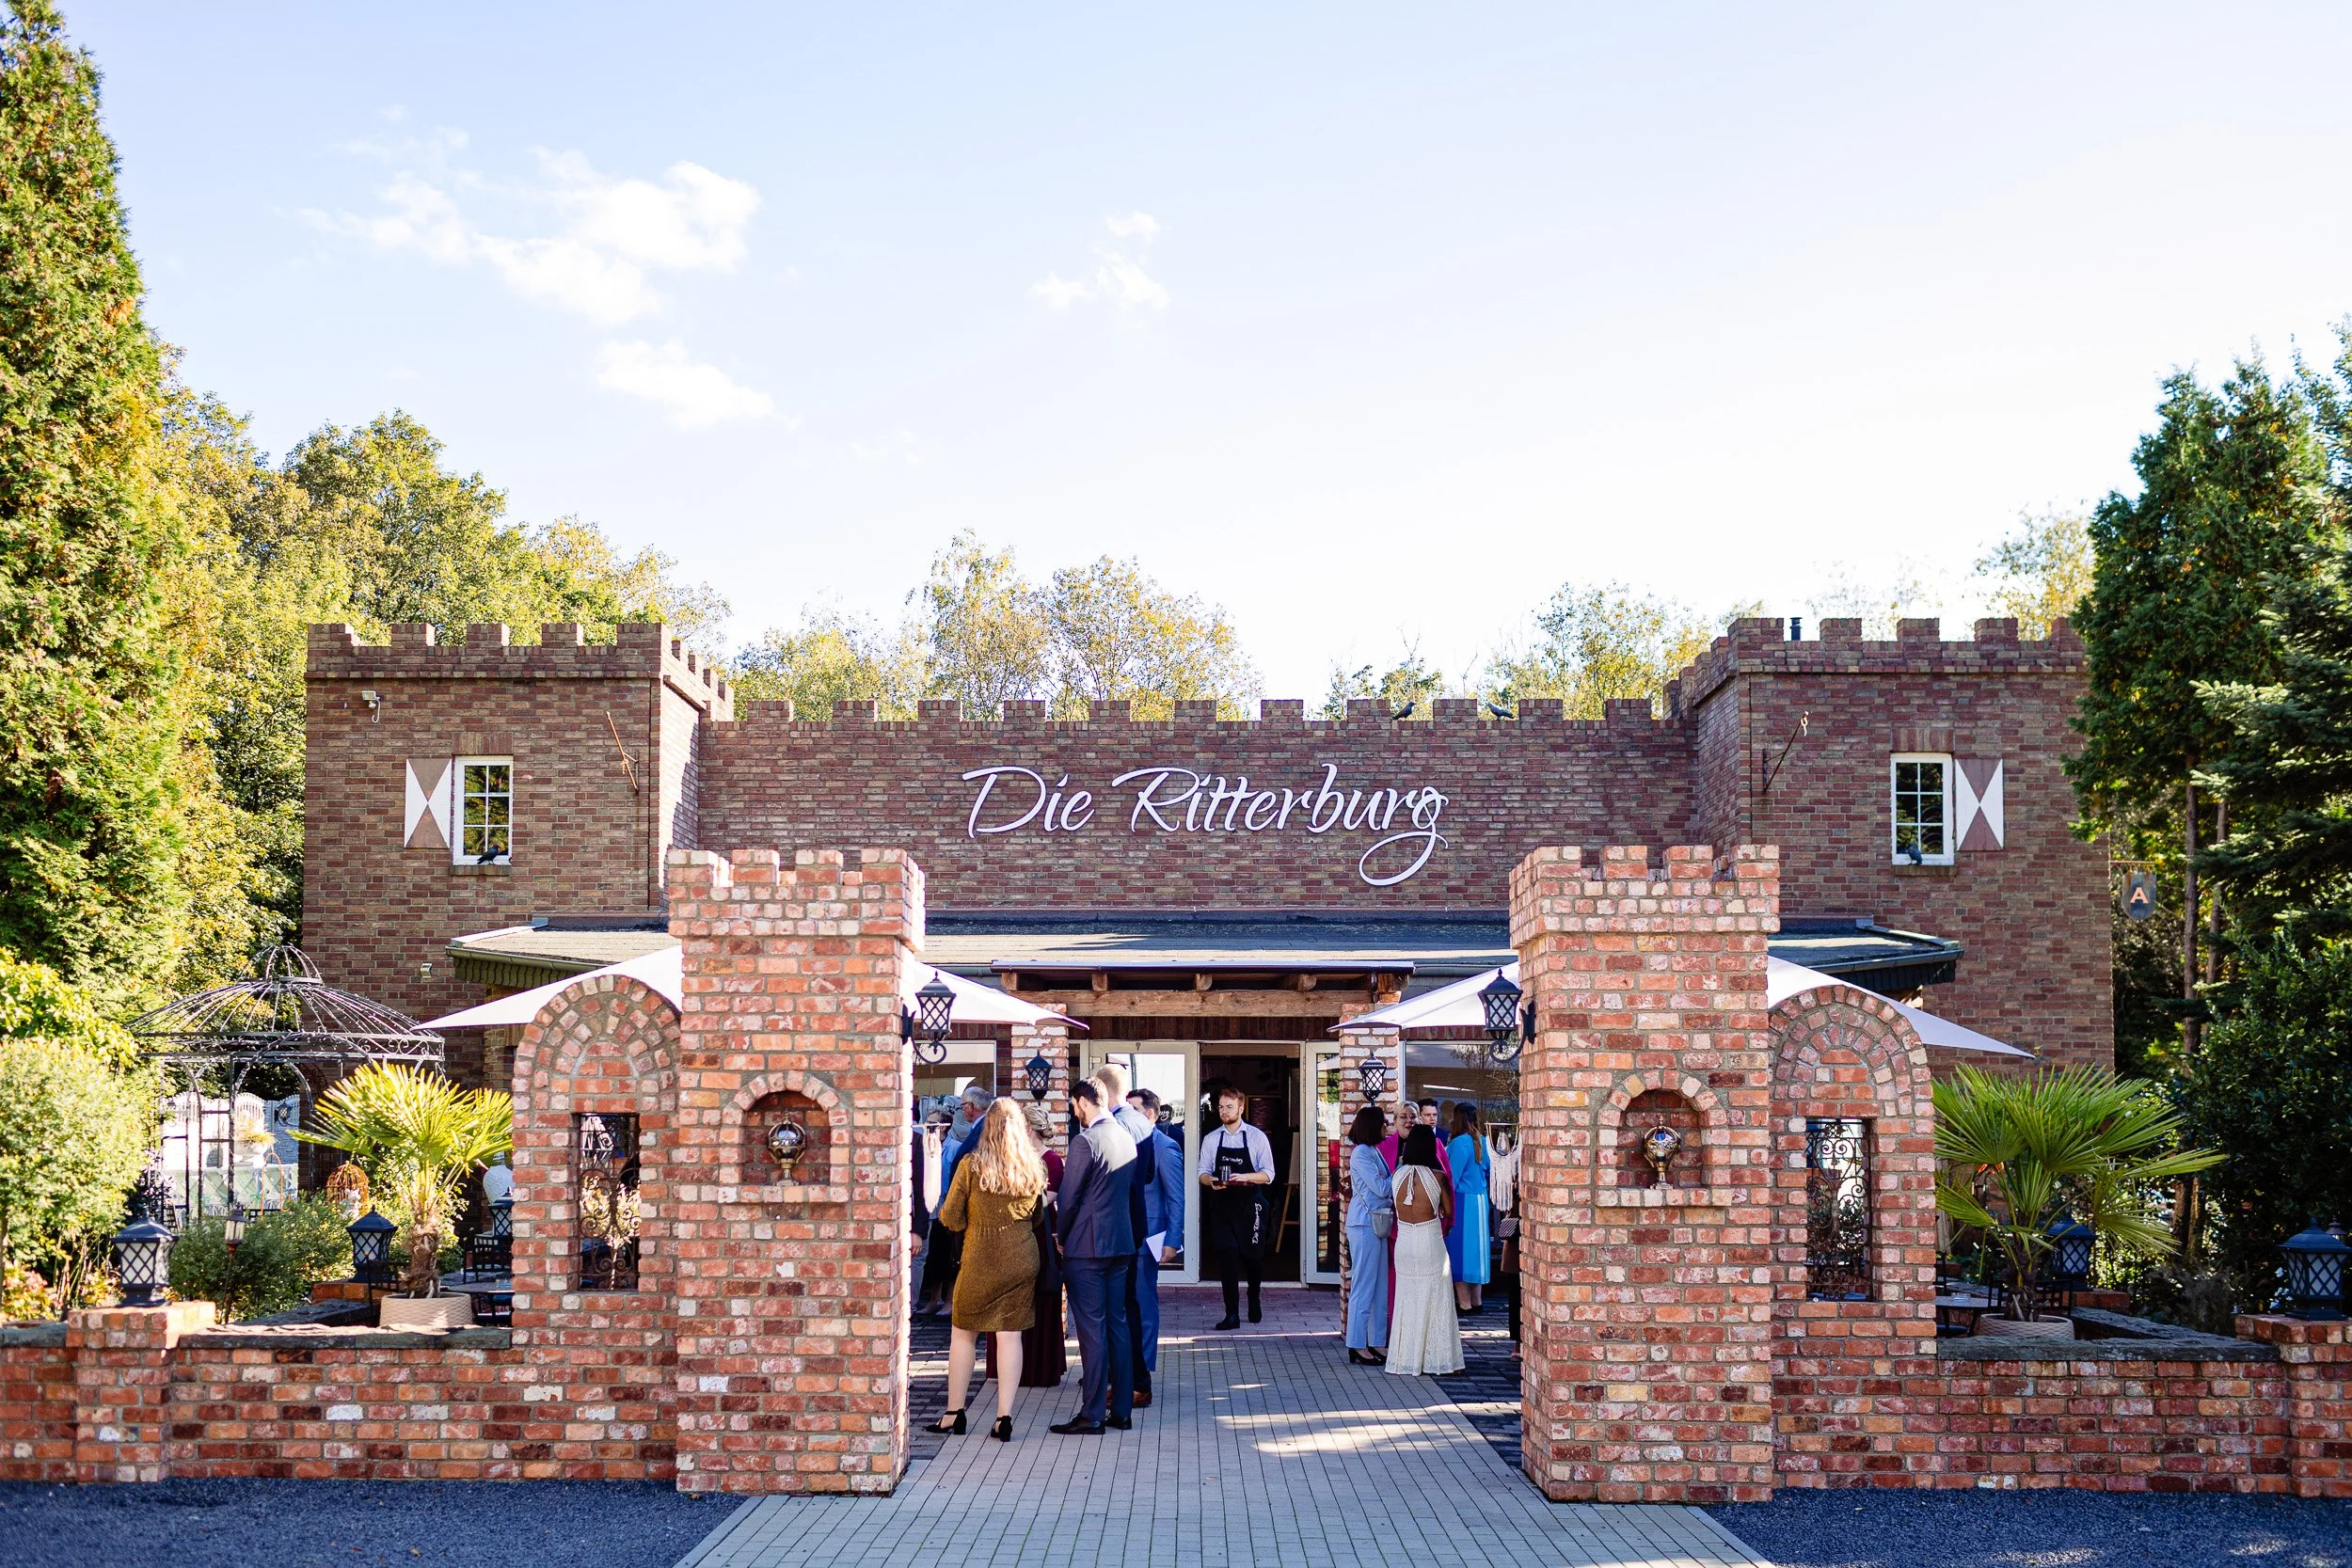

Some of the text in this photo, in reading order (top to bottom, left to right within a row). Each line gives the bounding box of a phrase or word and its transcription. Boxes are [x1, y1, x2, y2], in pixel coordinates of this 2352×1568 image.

[961, 763, 1450, 886] Die Ritterburg
[2129, 886, 2149, 904] A
